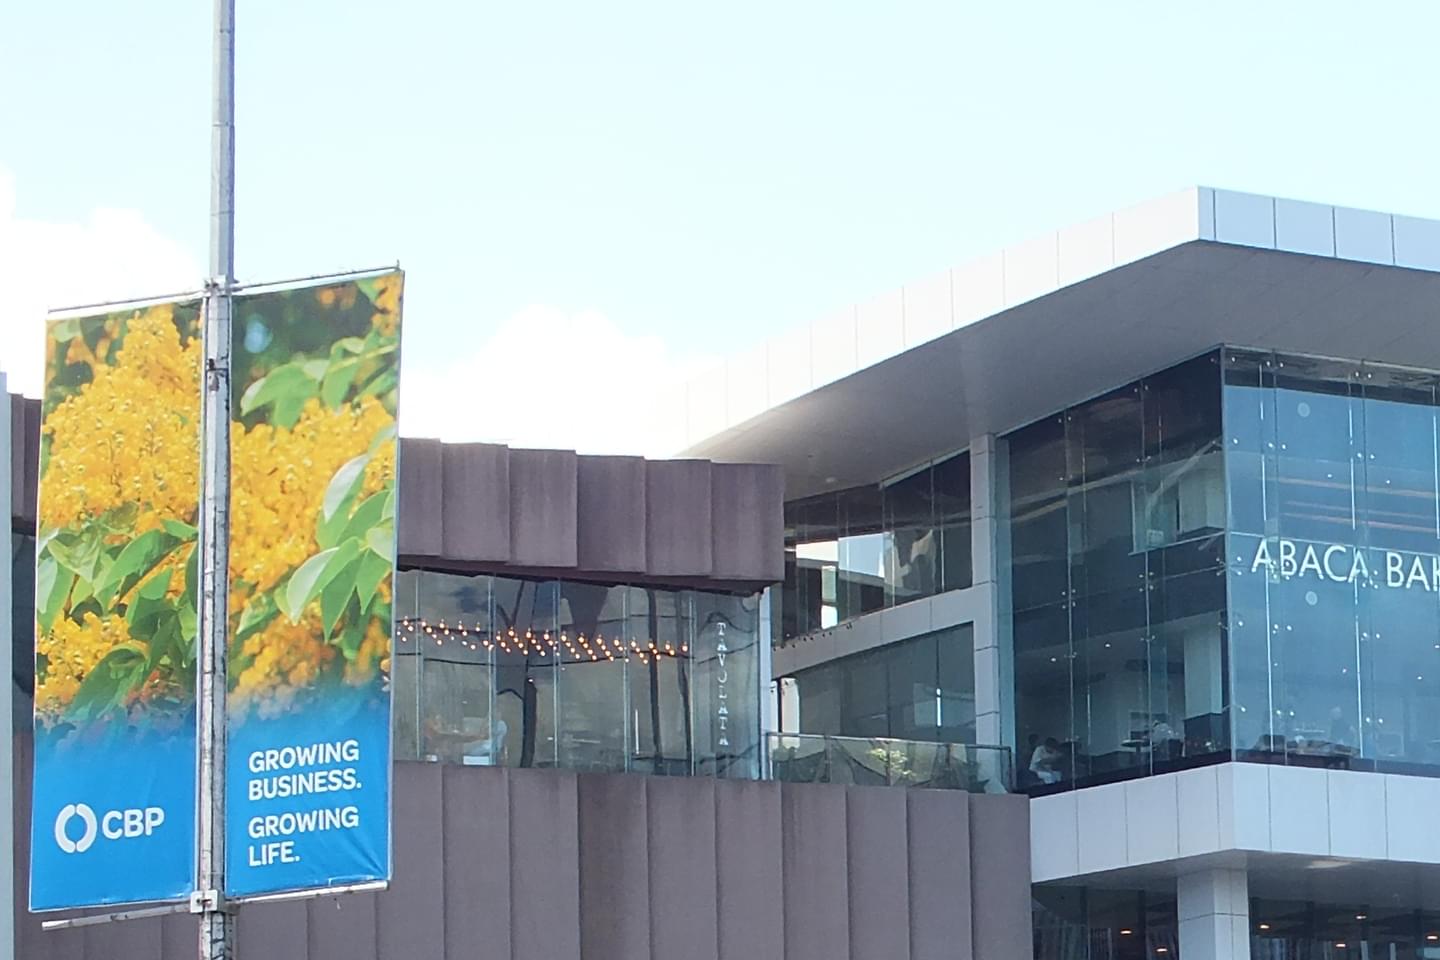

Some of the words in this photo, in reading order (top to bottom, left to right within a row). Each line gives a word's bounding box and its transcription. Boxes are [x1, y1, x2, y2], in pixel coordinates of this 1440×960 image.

[1251, 539, 1371, 584] ABACA
[248, 739, 360, 774] GROWING
[248, 768, 362, 801] BUSINESS.
[102, 807, 165, 840] CBP
[248, 806, 360, 839] GROWING
[248, 841, 301, 867] LIFE.
